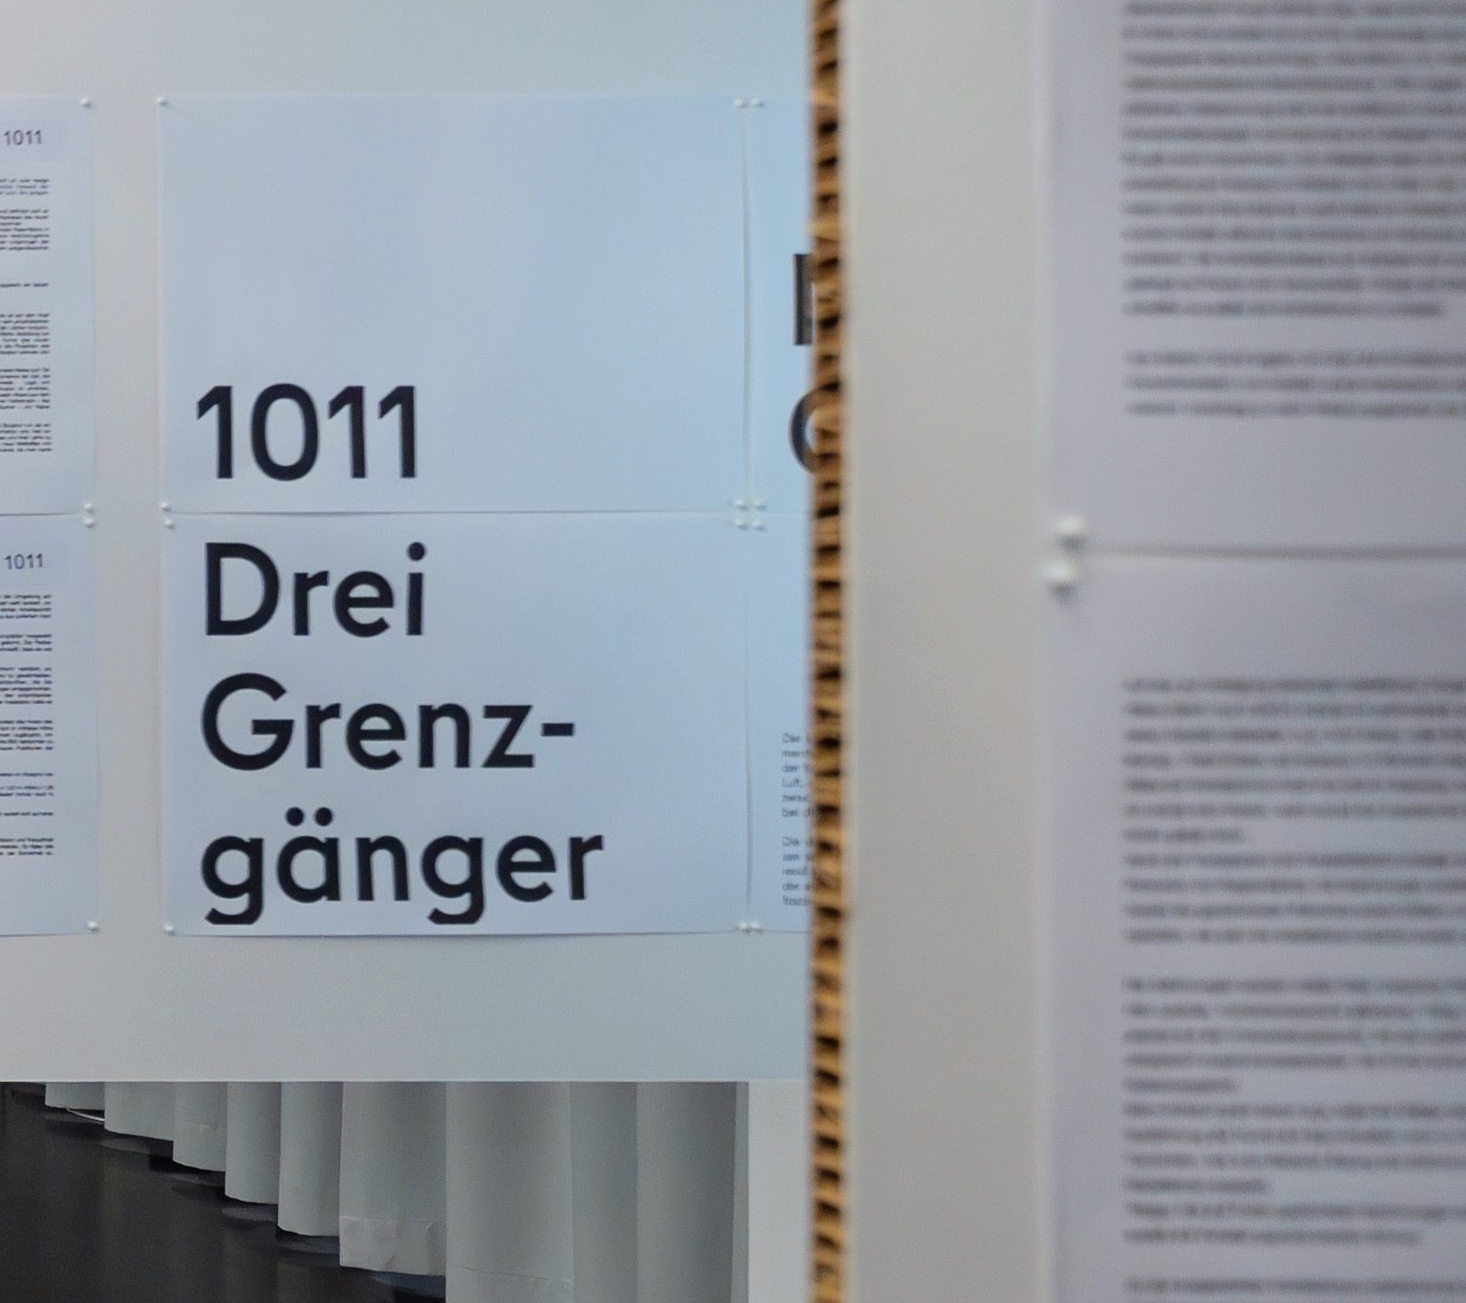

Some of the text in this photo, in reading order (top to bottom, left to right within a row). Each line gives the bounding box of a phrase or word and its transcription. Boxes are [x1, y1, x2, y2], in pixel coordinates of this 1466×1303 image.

[3, 129, 43, 146] 1011
[195, 381, 418, 482] 1011
[4, 553, 43, 569] 1011
[204, 540, 427, 639] Drei
[200, 670, 577, 772] Grenz-
[200, 805, 605, 927] gänger
